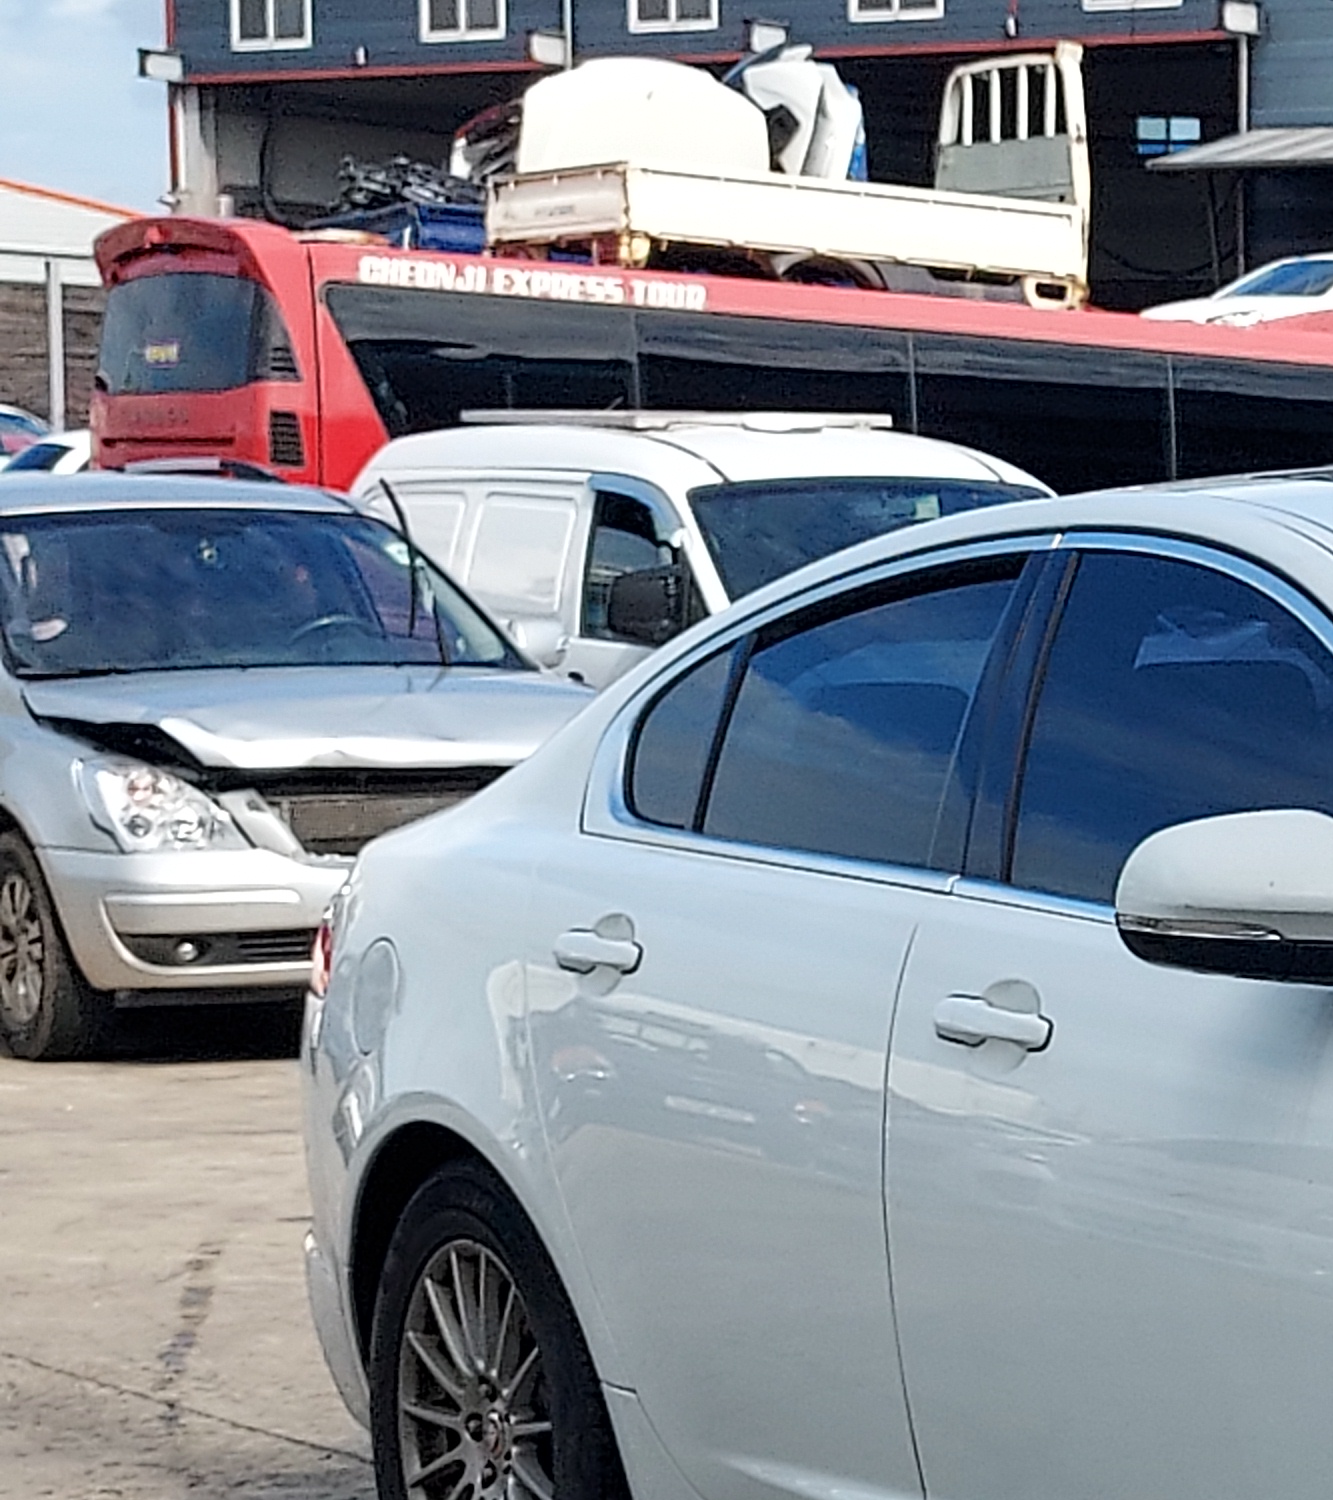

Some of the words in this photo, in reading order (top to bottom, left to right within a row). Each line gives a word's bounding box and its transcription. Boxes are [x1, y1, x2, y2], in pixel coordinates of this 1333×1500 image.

[358, 255, 487, 293] CHEONJI
[493, 267, 625, 305] EXPRESS
[630, 279, 707, 312] TOUR
